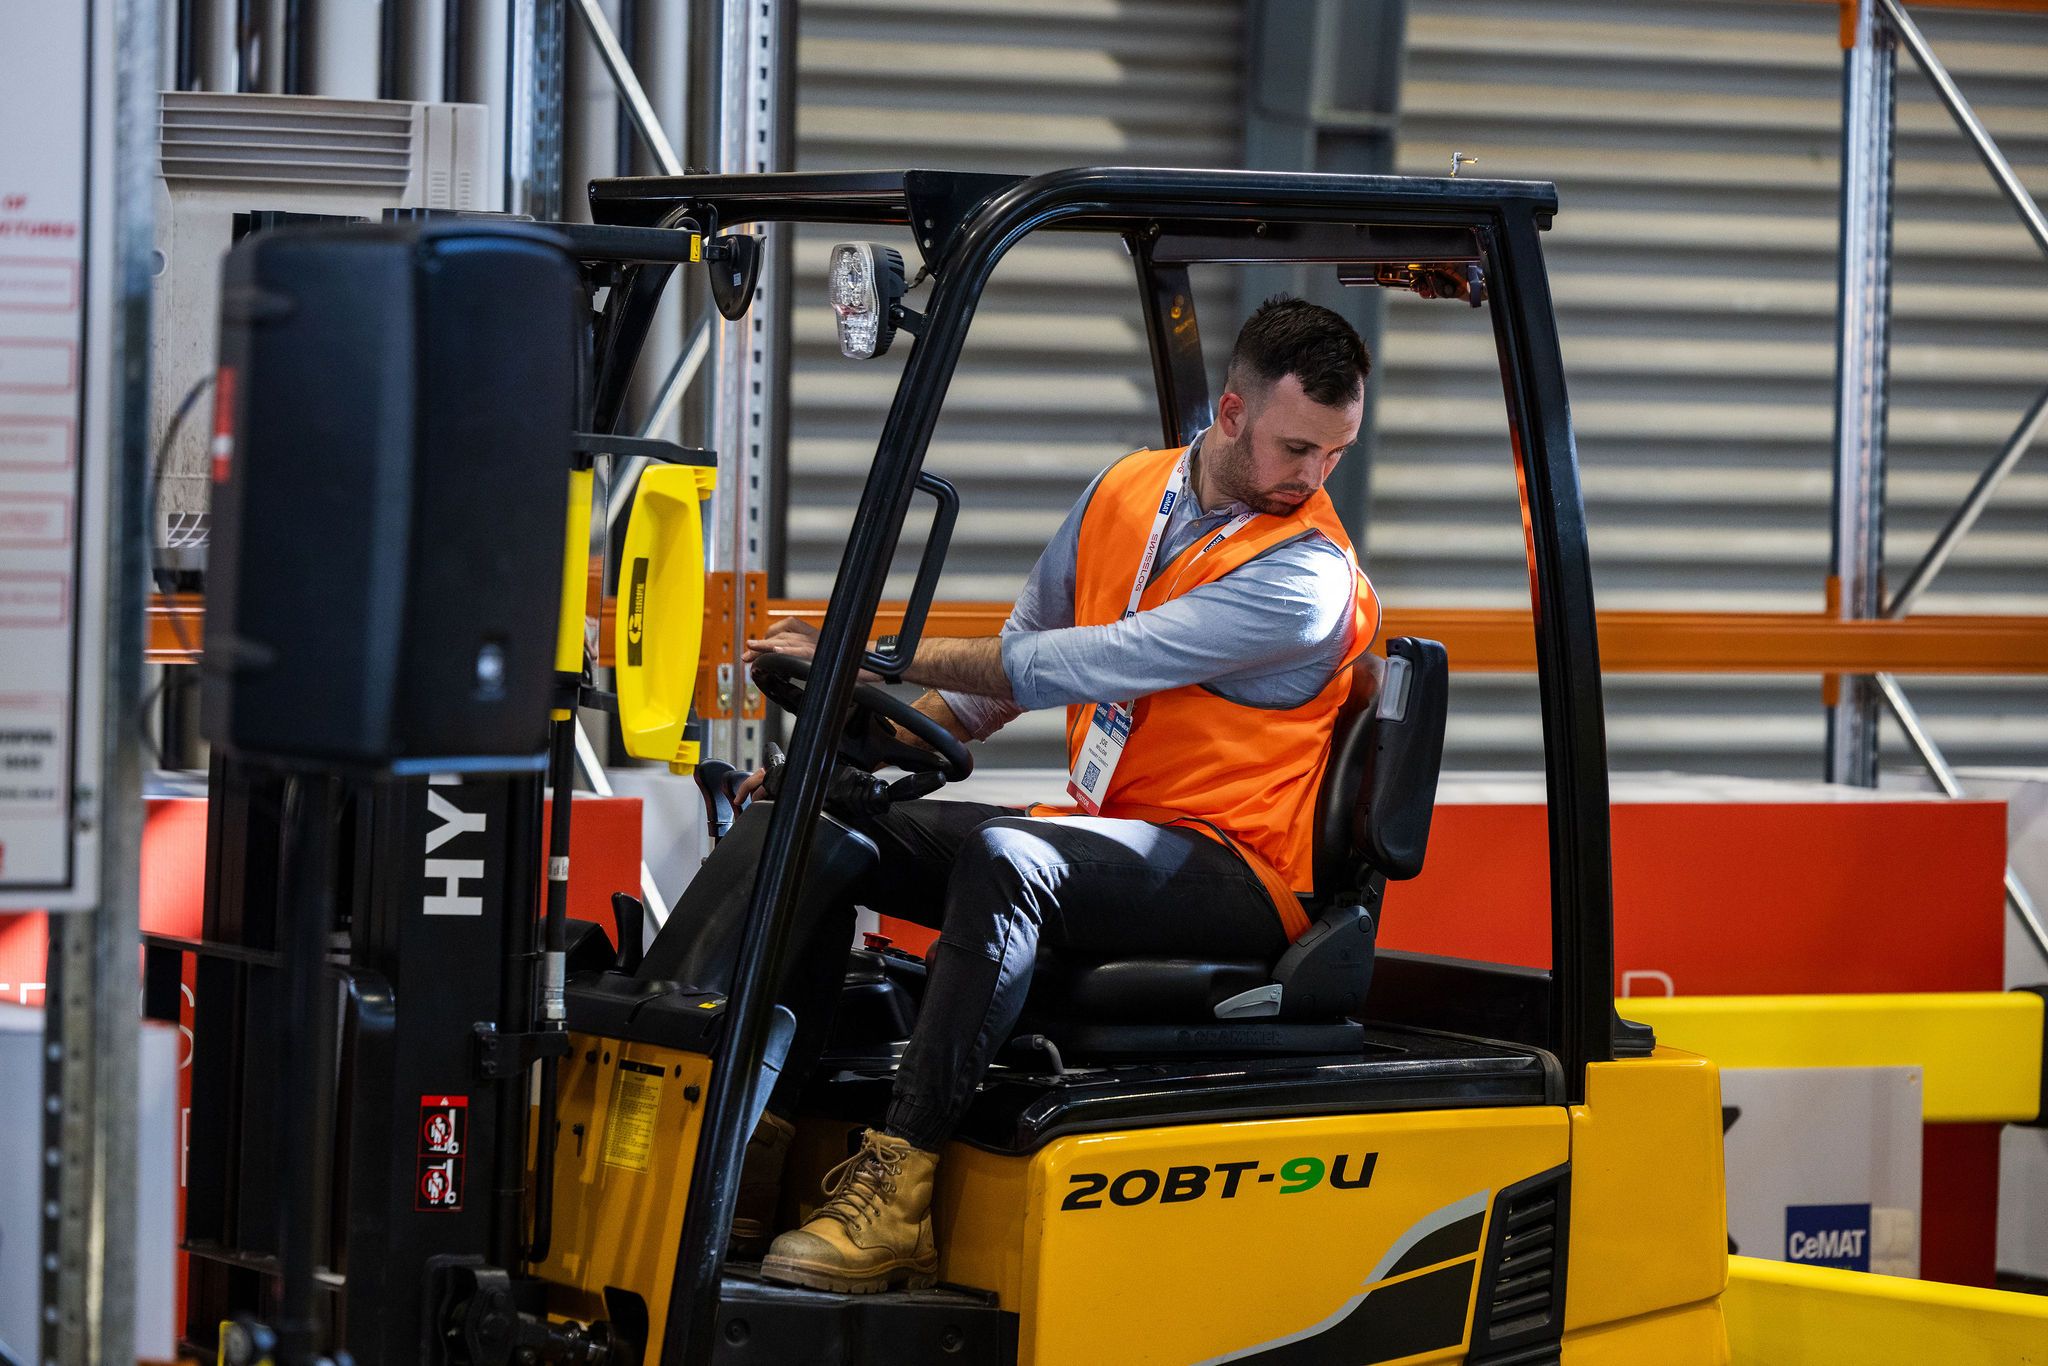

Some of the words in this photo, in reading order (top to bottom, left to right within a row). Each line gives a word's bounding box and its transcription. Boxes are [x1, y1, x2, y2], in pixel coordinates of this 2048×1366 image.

[1160, 492, 1174, 514] CeMAT
[1135, 533, 1159, 592] SWISSLOG
[423, 773, 487, 916] HY
[1060, 1152, 1379, 1211] 20BT-9U
[1789, 1229, 1866, 1260] CeMAT
